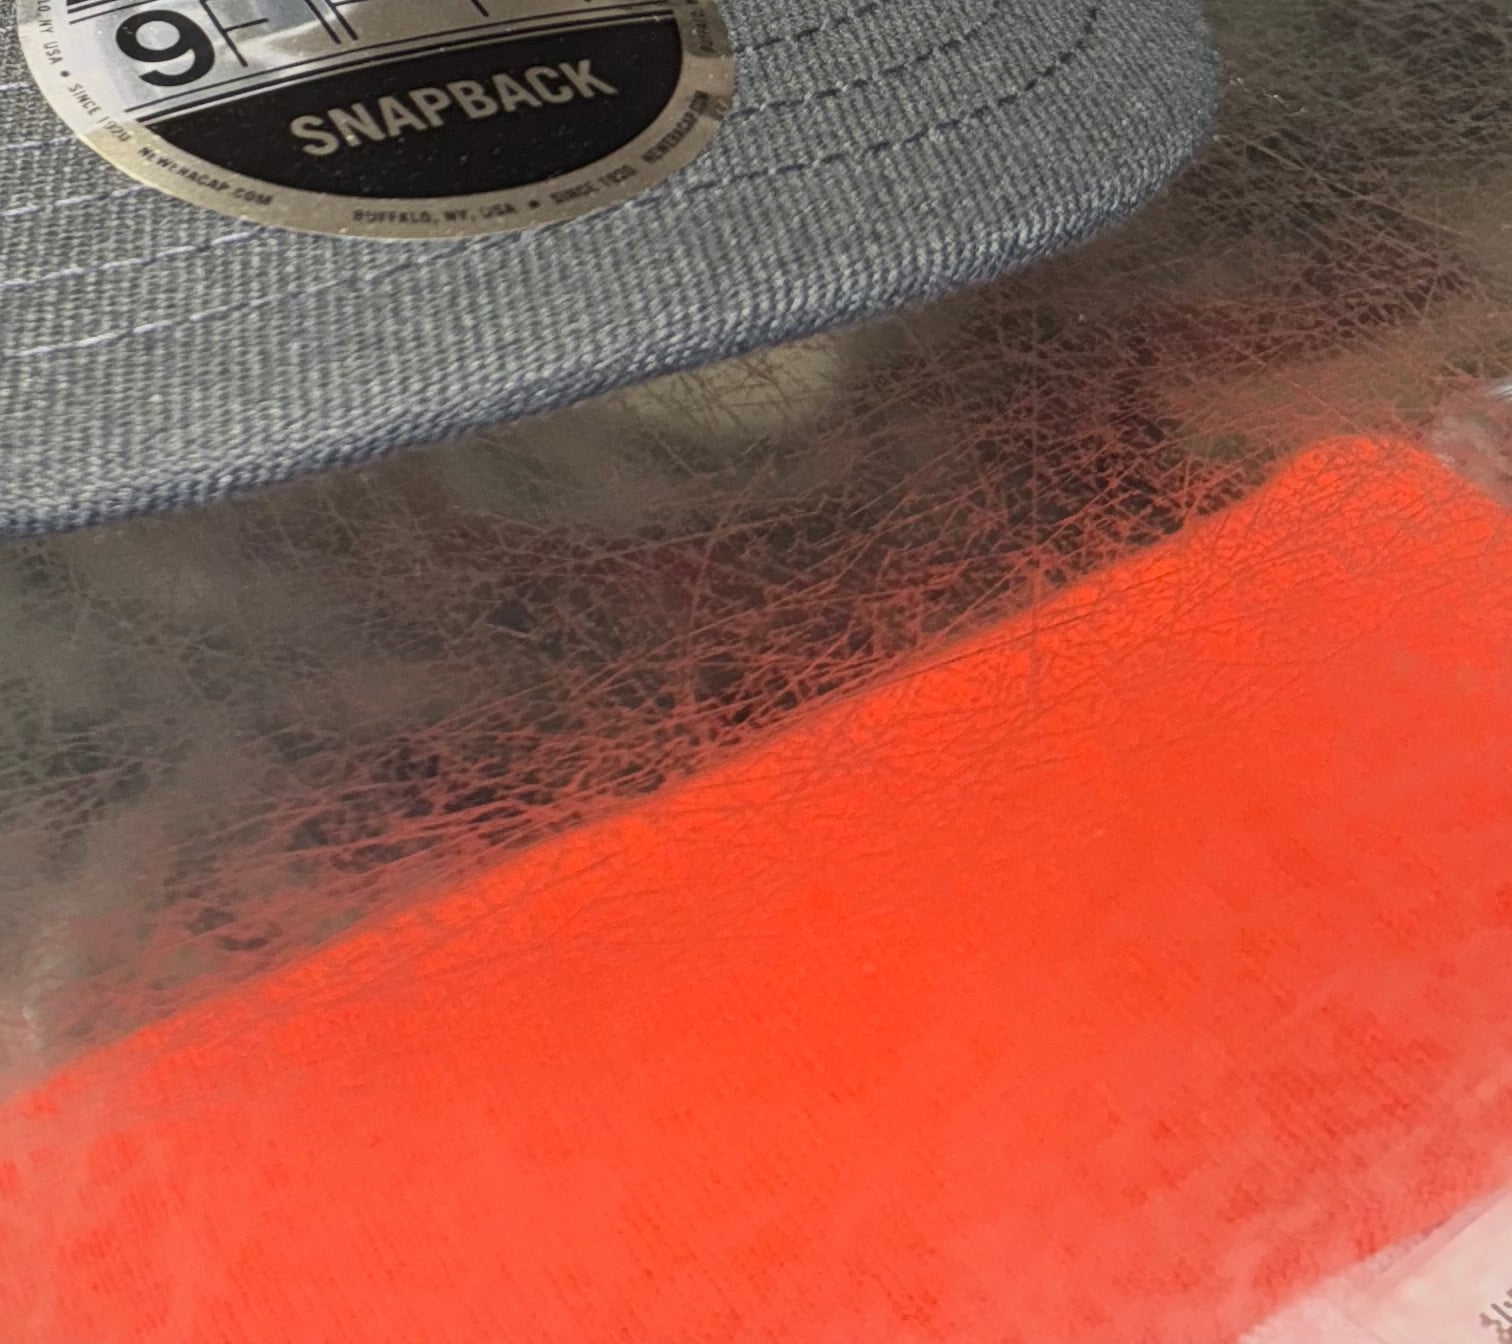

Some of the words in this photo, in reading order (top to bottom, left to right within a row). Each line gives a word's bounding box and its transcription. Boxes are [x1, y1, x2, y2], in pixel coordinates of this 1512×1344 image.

[43, 40, 64, 65] USA
[68, 82, 102, 116] SINCE
[96, 115, 133, 143] 1920
[289, 59, 619, 156] SNAPBACK
